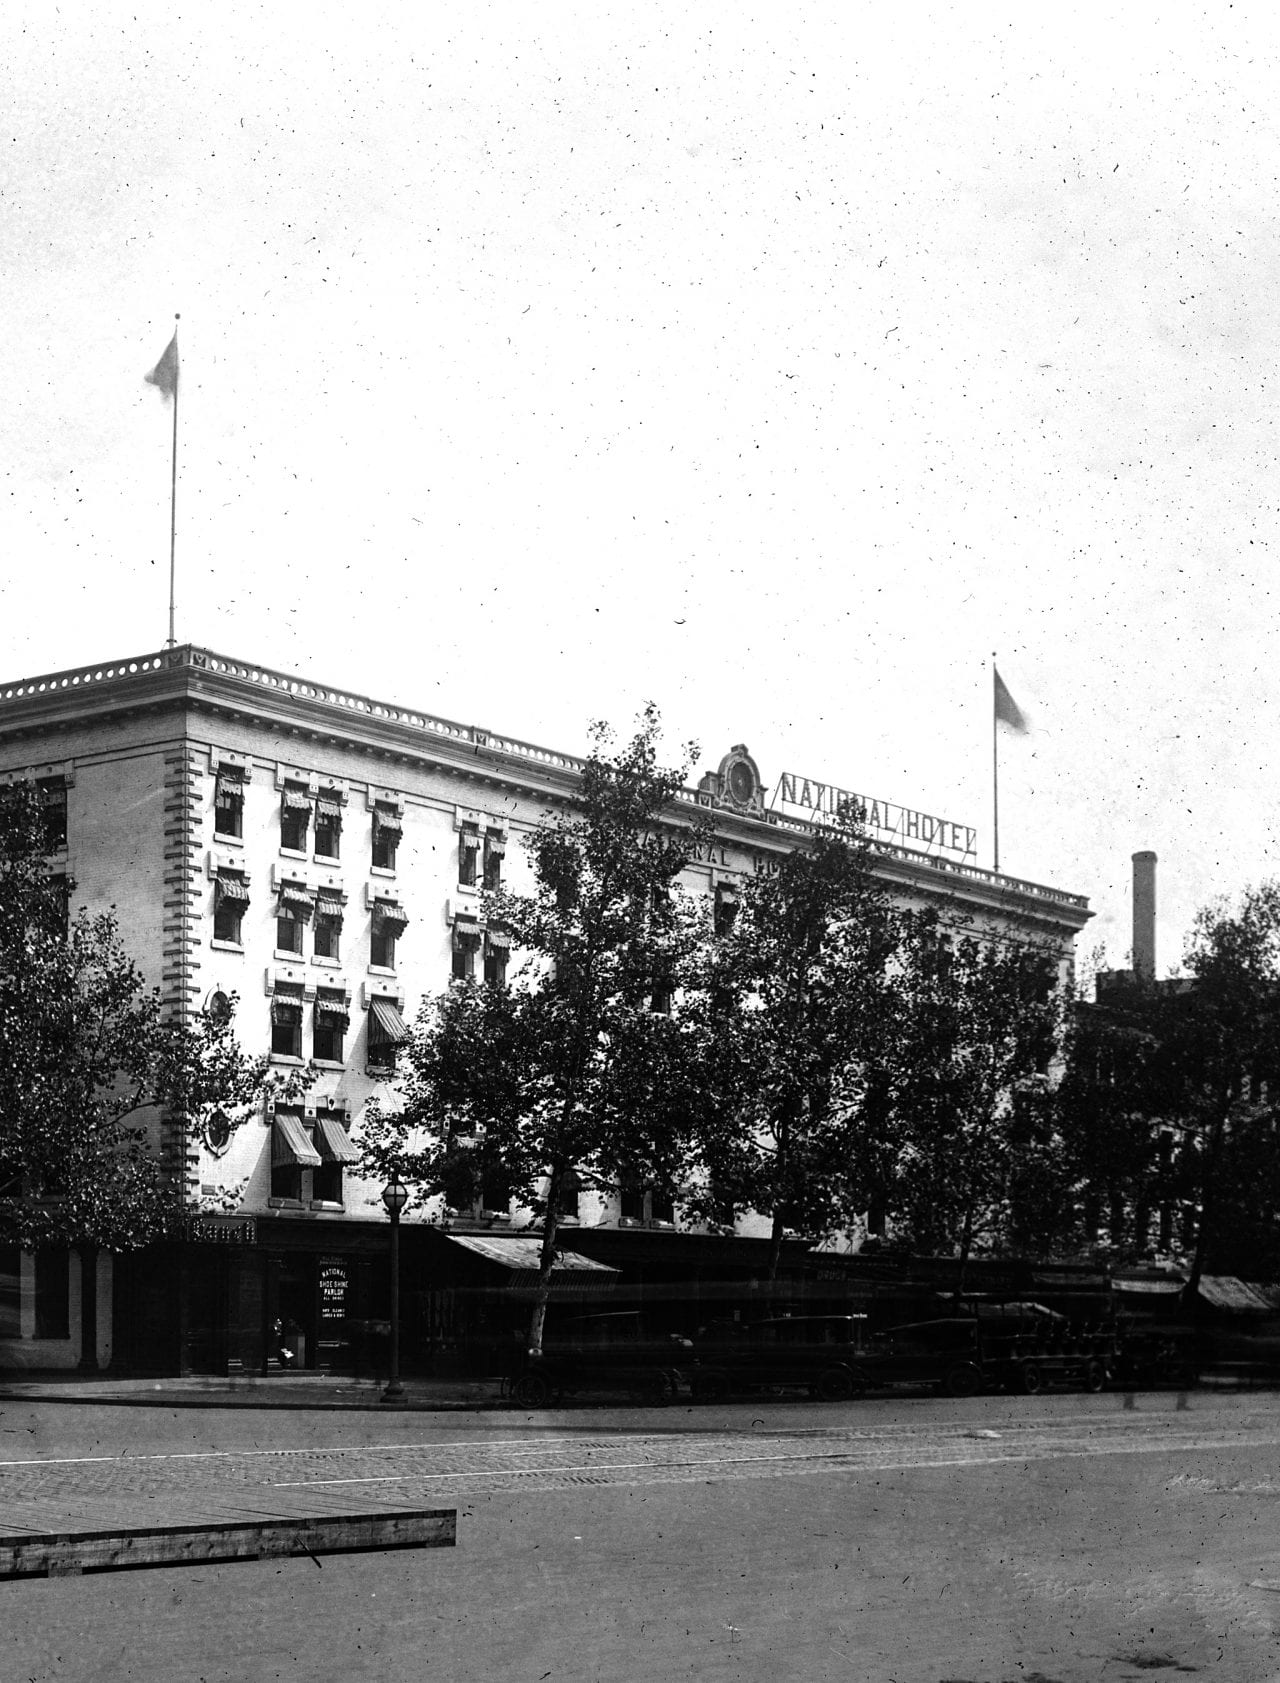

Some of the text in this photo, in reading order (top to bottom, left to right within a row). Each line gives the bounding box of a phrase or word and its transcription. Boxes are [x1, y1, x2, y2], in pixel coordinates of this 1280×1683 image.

[907, 809, 977, 855] HOTEL
[321, 1268, 346, 1279] NATIONAL
[319, 1280, 349, 1288] SHOE SHINE
[323, 1288, 344, 1296] PARLOR
